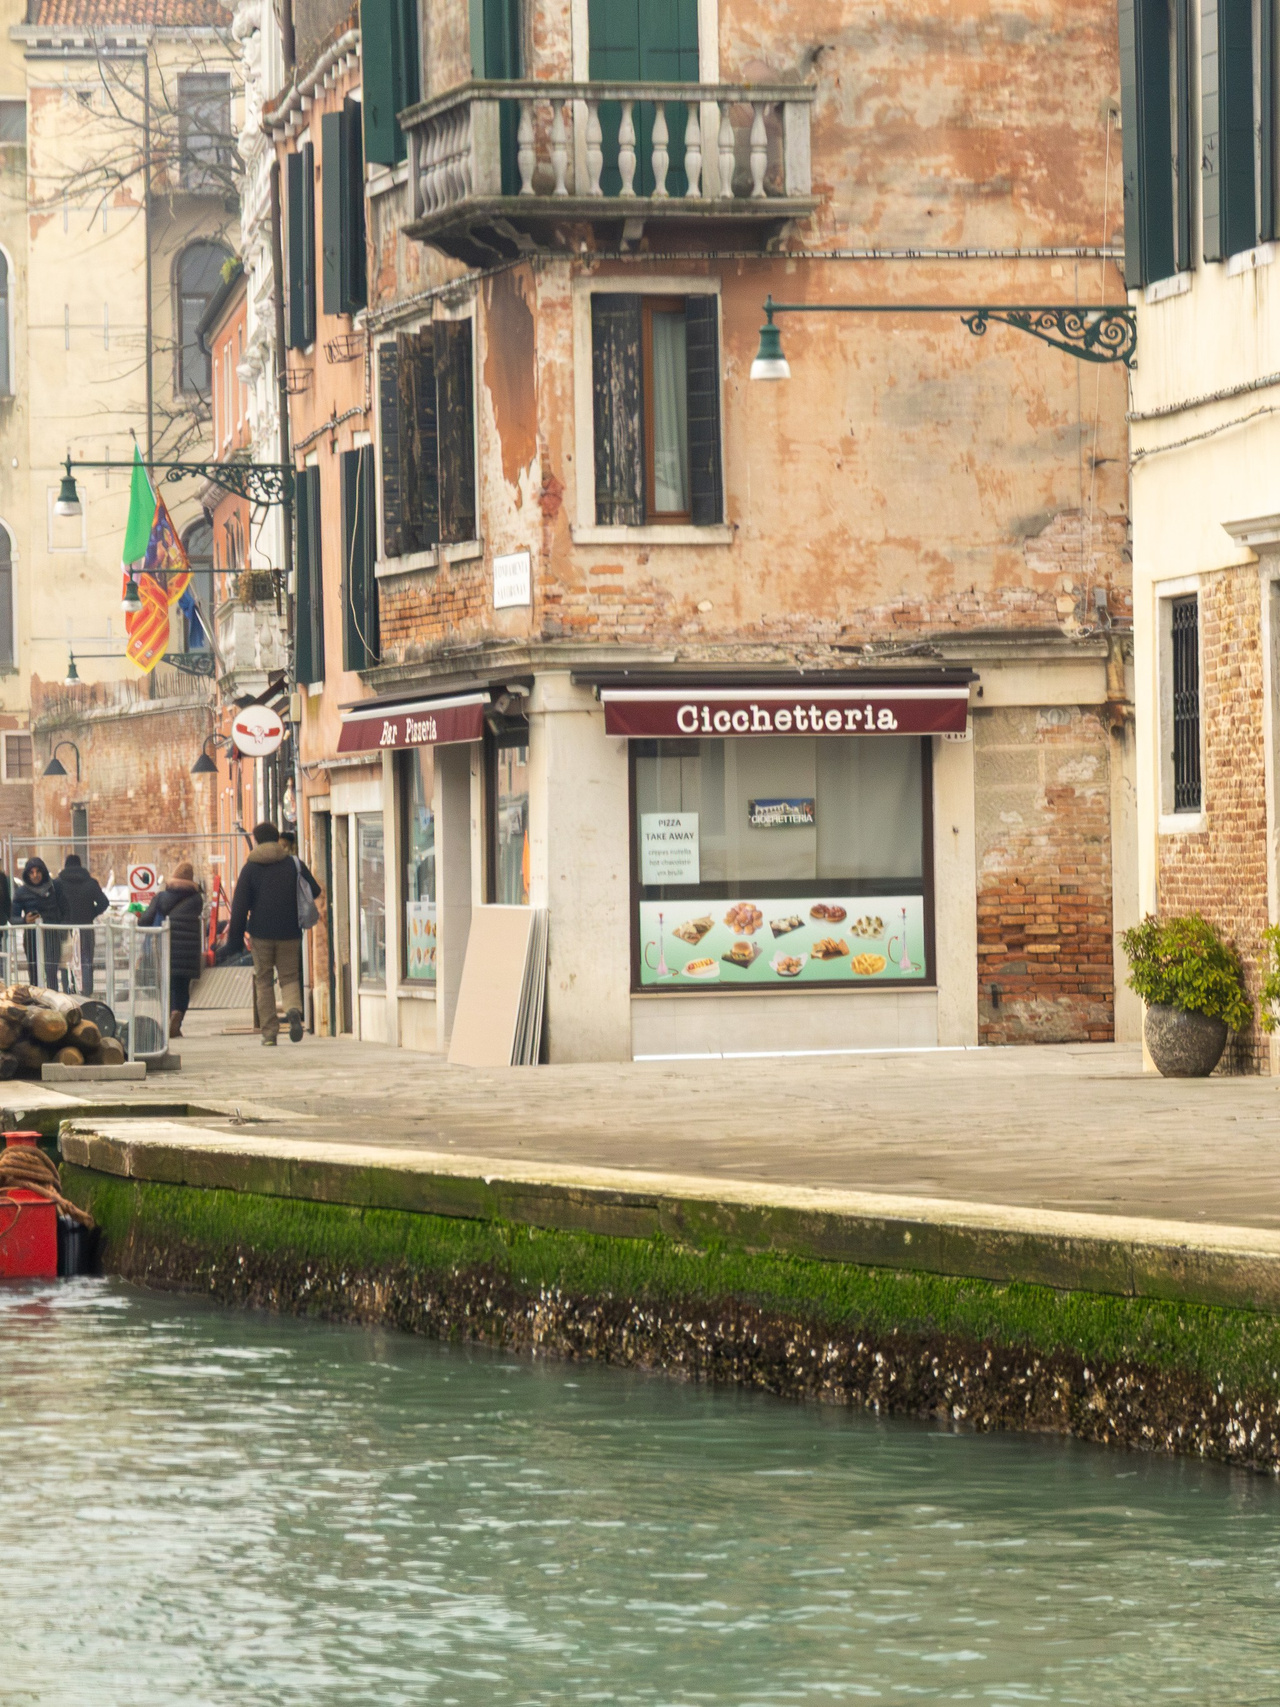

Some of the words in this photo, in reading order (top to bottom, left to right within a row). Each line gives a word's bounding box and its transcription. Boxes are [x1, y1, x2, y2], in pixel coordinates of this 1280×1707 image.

[676, 704, 899, 733] Cicchetteria
[379, 720, 398, 745] Bar
[404, 715, 438, 743] Pizzeria
[658, 819, 681, 827] PIZZA
[645, 832, 667, 841] TAKE
[668, 832, 694, 840] AWAY
